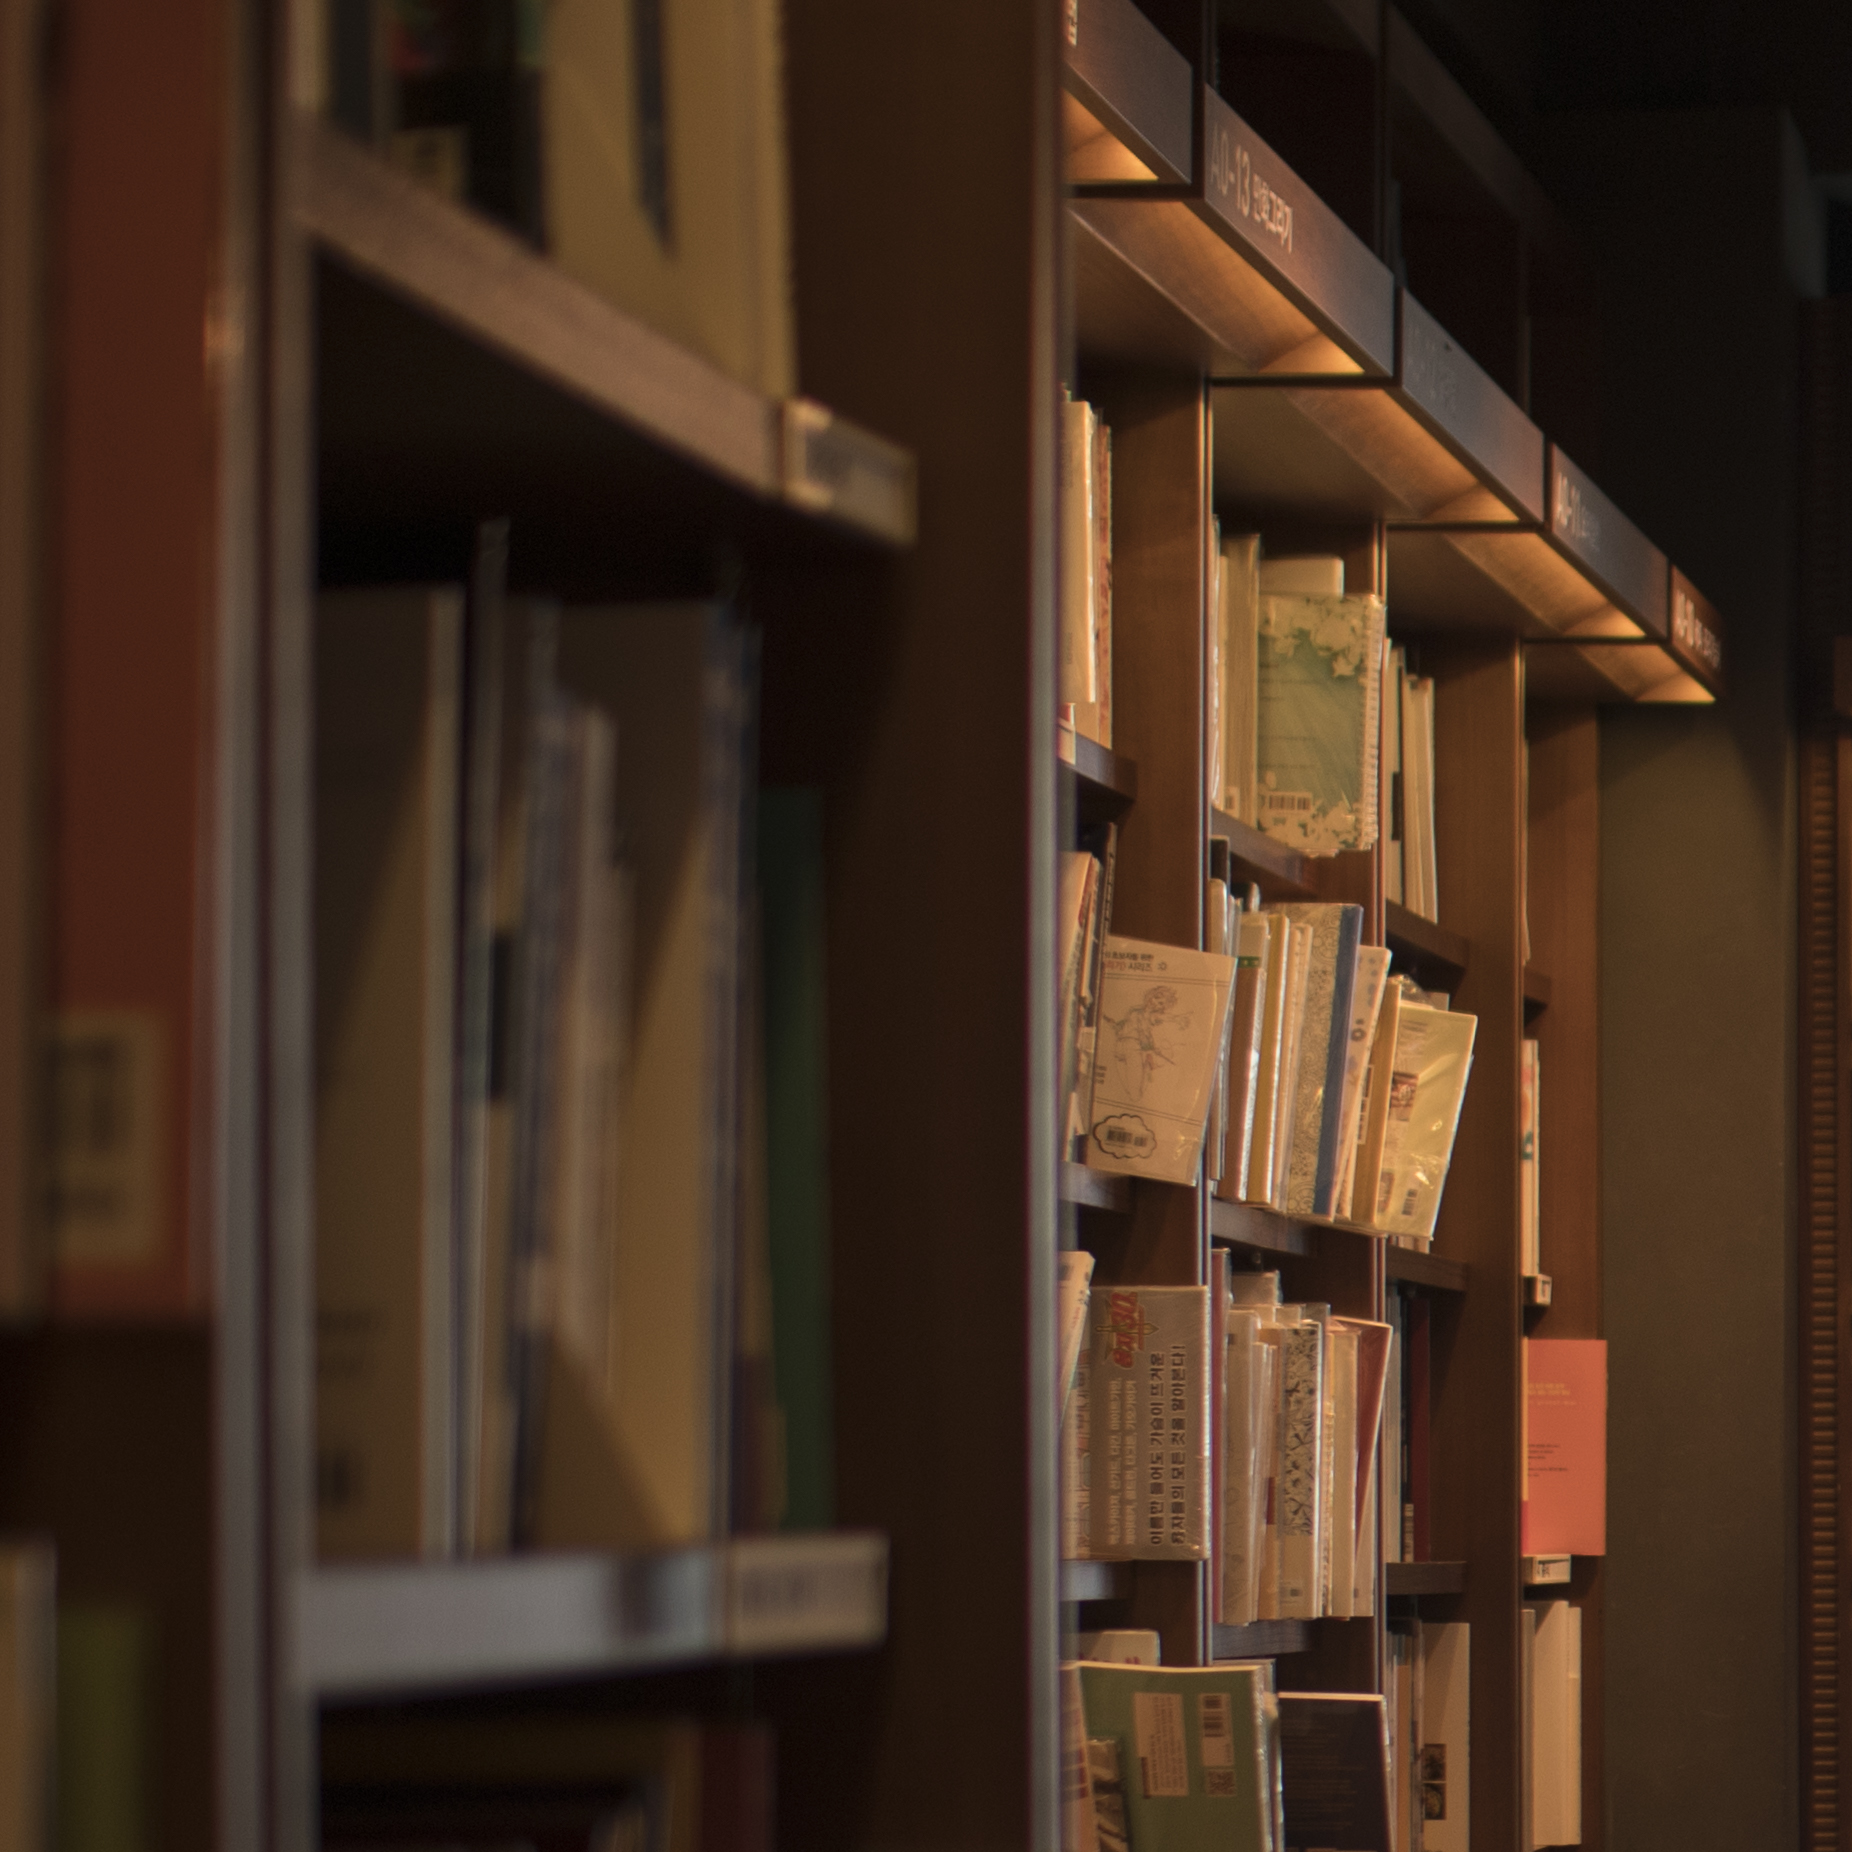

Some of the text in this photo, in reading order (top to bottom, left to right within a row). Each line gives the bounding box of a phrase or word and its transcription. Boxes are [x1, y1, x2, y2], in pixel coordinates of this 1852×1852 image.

[1150, 1351, 1164, 1545] 이름만 들어도 가슴이 뜨거운
[1171, 1345, 1186, 1545] 용자들의 모든 것을 알아본다!
